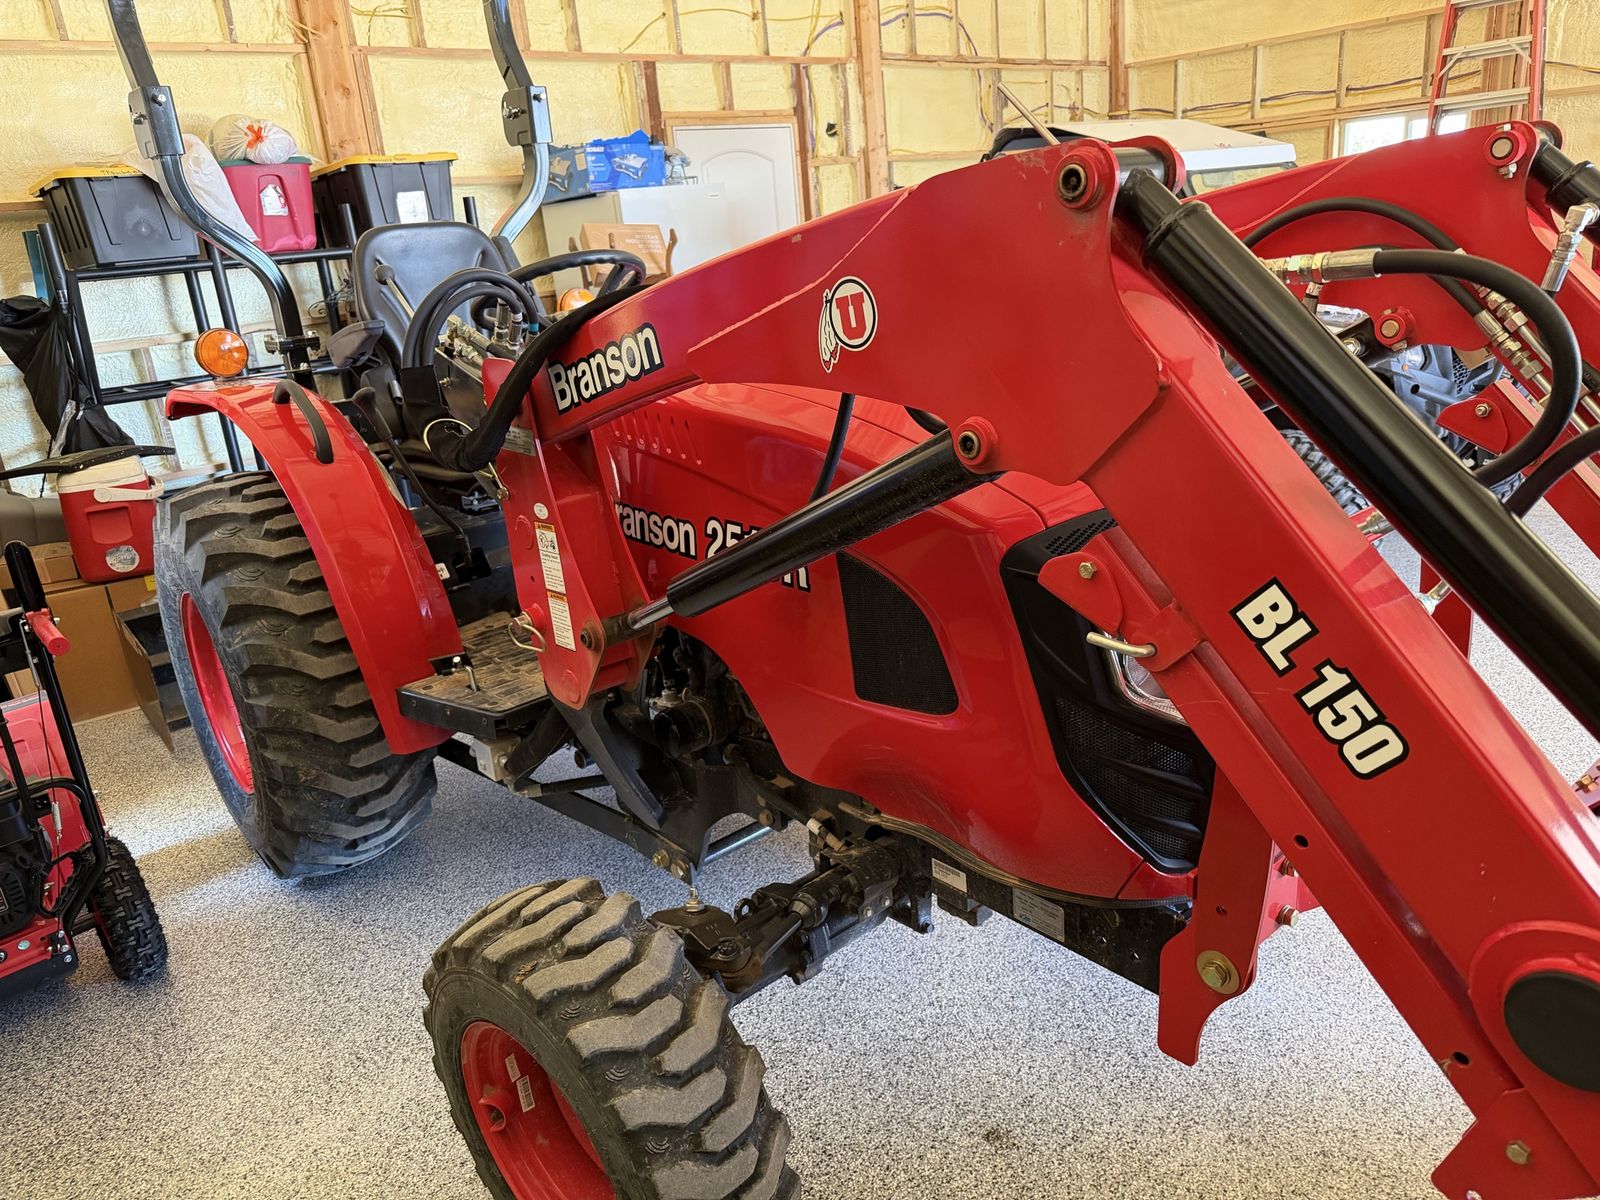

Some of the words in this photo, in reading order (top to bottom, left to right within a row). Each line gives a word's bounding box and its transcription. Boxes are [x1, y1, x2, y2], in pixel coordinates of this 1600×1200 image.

[834, 290, 867, 341] U
[547, 325, 663, 412] Branson
[614, 502, 697, 557] ranson
[1233, 580, 1315, 674] BL
[1298, 661, 1406, 777] 150
